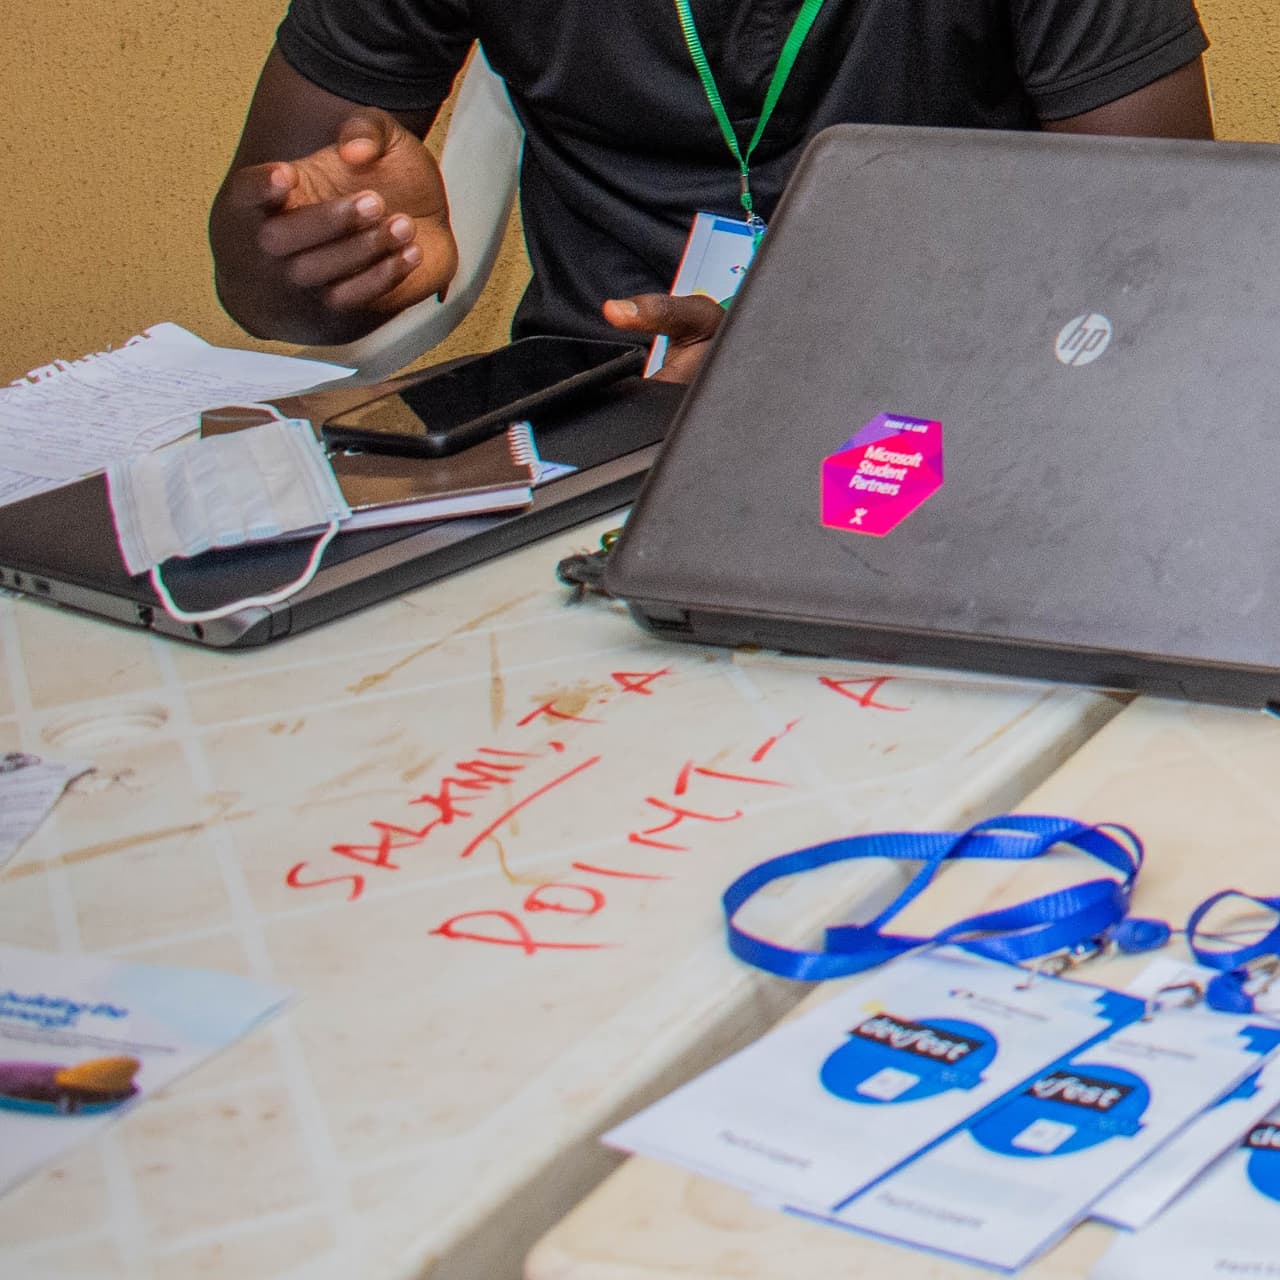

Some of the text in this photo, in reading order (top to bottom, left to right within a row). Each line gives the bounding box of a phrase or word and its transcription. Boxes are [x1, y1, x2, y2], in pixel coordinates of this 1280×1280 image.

[1056, 313, 1111, 366] hp
[857, 459, 909, 482] Student
[863, 445, 924, 469] Microsoft
[849, 475, 901, 497] Partners
[859, 1016, 971, 1061] devfest
[1032, 1076, 1122, 1108] vfest
